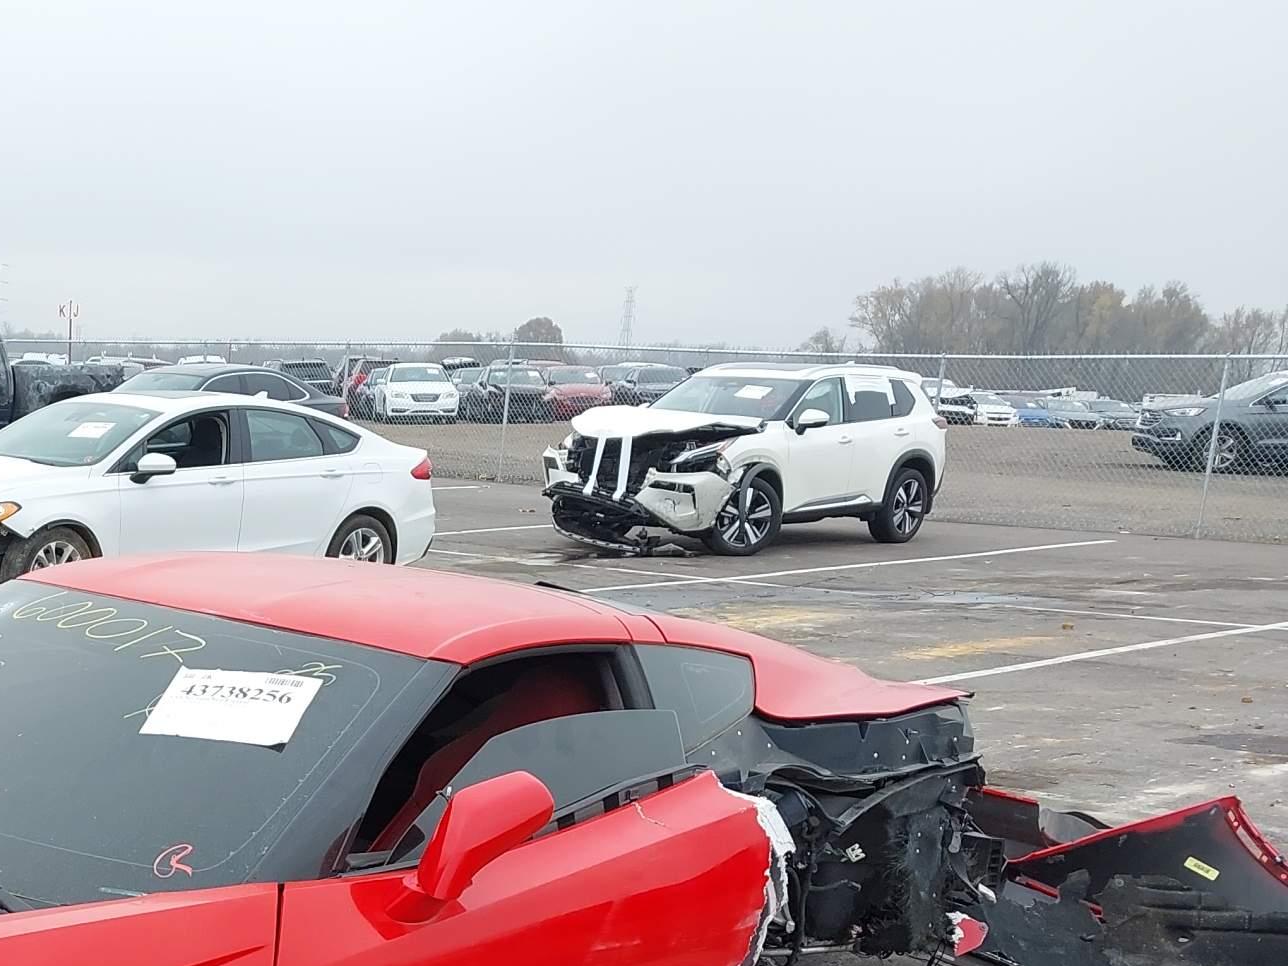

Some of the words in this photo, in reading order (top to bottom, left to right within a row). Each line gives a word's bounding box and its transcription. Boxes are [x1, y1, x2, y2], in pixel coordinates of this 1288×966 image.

[59, 304, 66, 317] K
[12, 590, 206, 663] 600017
[181, 684, 294, 704] 43738256
